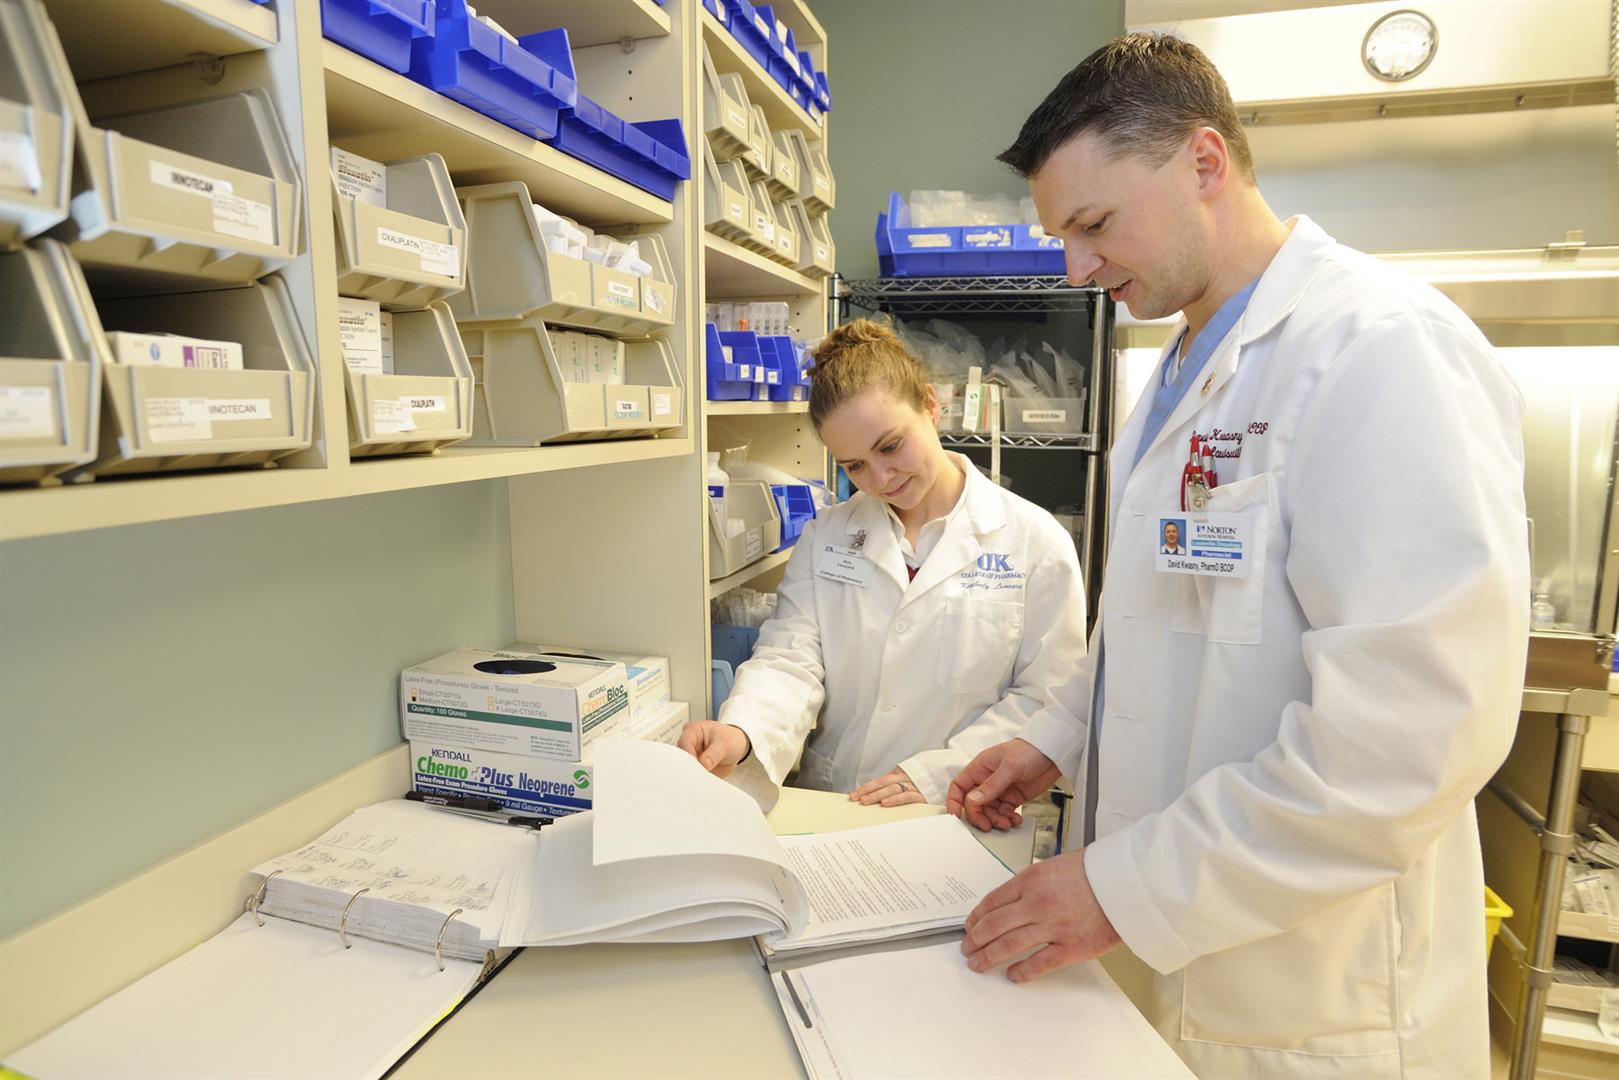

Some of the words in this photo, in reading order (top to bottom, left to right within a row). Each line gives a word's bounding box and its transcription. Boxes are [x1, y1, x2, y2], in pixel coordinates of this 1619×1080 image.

[381, 232, 420, 249] OXALIPLATIN
[1206, 525, 1236, 535] NORTON
[819, 569, 836, 577] College
[1167, 559, 1181, 568] David
[1200, 562, 1219, 572] PharmD
[1220, 563, 1235, 573] BCOP
[960, 571, 985, 579] COLLEGE
[985, 572, 994, 580] OF
[434, 679, 470, 689] (Procedures)
[470, 682, 490, 690] Gloves
[494, 685, 519, 694] Textured
[411, 704, 437, 714] Quantity:
[437, 707, 447, 715] 100
[447, 708, 467, 718] Gloves
[431, 748, 472, 763] KENDALL
[417, 755, 469, 780] Chemo
[519, 772, 576, 798] Neoprene
[417, 774, 445, 785] Latex-Free
[445, 778, 461, 788] Exam
[461, 781, 488, 792] Procedure
[488, 786, 508, 796] Gloves
[511, 801, 521, 809] mil
[521, 803, 543, 813] Gauge
